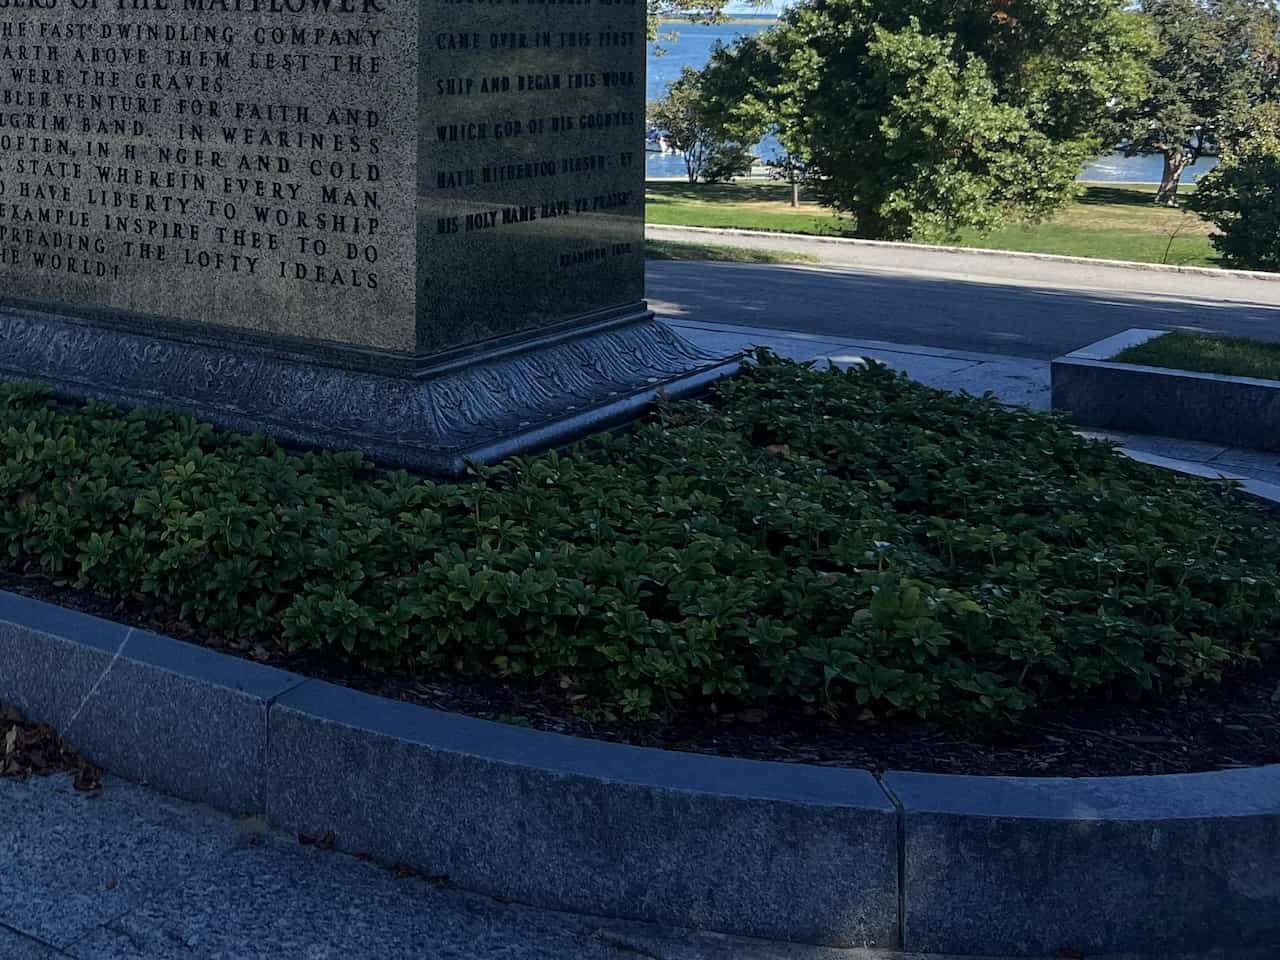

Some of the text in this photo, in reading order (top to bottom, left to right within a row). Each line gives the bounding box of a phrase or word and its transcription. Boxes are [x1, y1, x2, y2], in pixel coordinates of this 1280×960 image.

[99, 23, 234, 43] DWINDLING
[253, 26, 382, 47] COMPANY
[437, 32, 634, 49] CAME OVER IN THIS FIRST
[73, 46, 147, 65] ABOVE
[165, 49, 231, 69] THEM
[249, 51, 310, 72] LEST
[330, 54, 381, 75] THE
[10, 67, 64, 85] WERE
[80, 70, 119, 88] THE
[437, 78, 472, 95] SHIP
[481, 76, 510, 93] AND
[518, 74, 561, 91] BEGAN
[568, 73, 596, 89] THIS
[62, 92, 163, 115] VENTURE
[178, 98, 220, 119] FOR
[234, 101, 309, 124] FAITH
[325, 106, 380, 128] AND
[80, 117, 154, 138] BAND.
[177, 123, 204, 142] IN
[220, 126, 380, 154] WEARINESS
[437, 123, 486, 142] WHICH
[495, 121, 521, 138] GOD
[529, 118, 543, 134] OF
[0, 134, 77, 157] OFTEN,
[85, 141, 109, 159] IN
[124, 143, 225, 169] HNGER
[237, 152, 290, 174] AND
[308, 157, 381, 182] COLD
[16, 158, 81, 180] STATE
[95, 165, 206, 192] WHEREIN
[222, 176, 302, 201] EVERY
[437, 169, 474, 188] HATH
[19, 182, 71, 204] HAVE
[87, 189, 189, 216] LIBERTY
[205, 200, 237, 221] TO
[254, 205, 380, 236] WORSHIP
[437, 217, 458, 234] HIS
[465, 211, 497, 232] HOLY
[502, 206, 537, 224] NAME
[541, 201, 569, 219] HAVE
[104, 214, 200, 242] INSPIRE
[215, 226, 279, 252] THEE
[297, 235, 327, 257] TO
[345, 240, 379, 263] DO
[32, 252, 119, 280] WORLD!
[122, 240, 167, 263] THE
[183, 248, 260, 274] LOFTY
[279, 259, 379, 289] IDEALS
